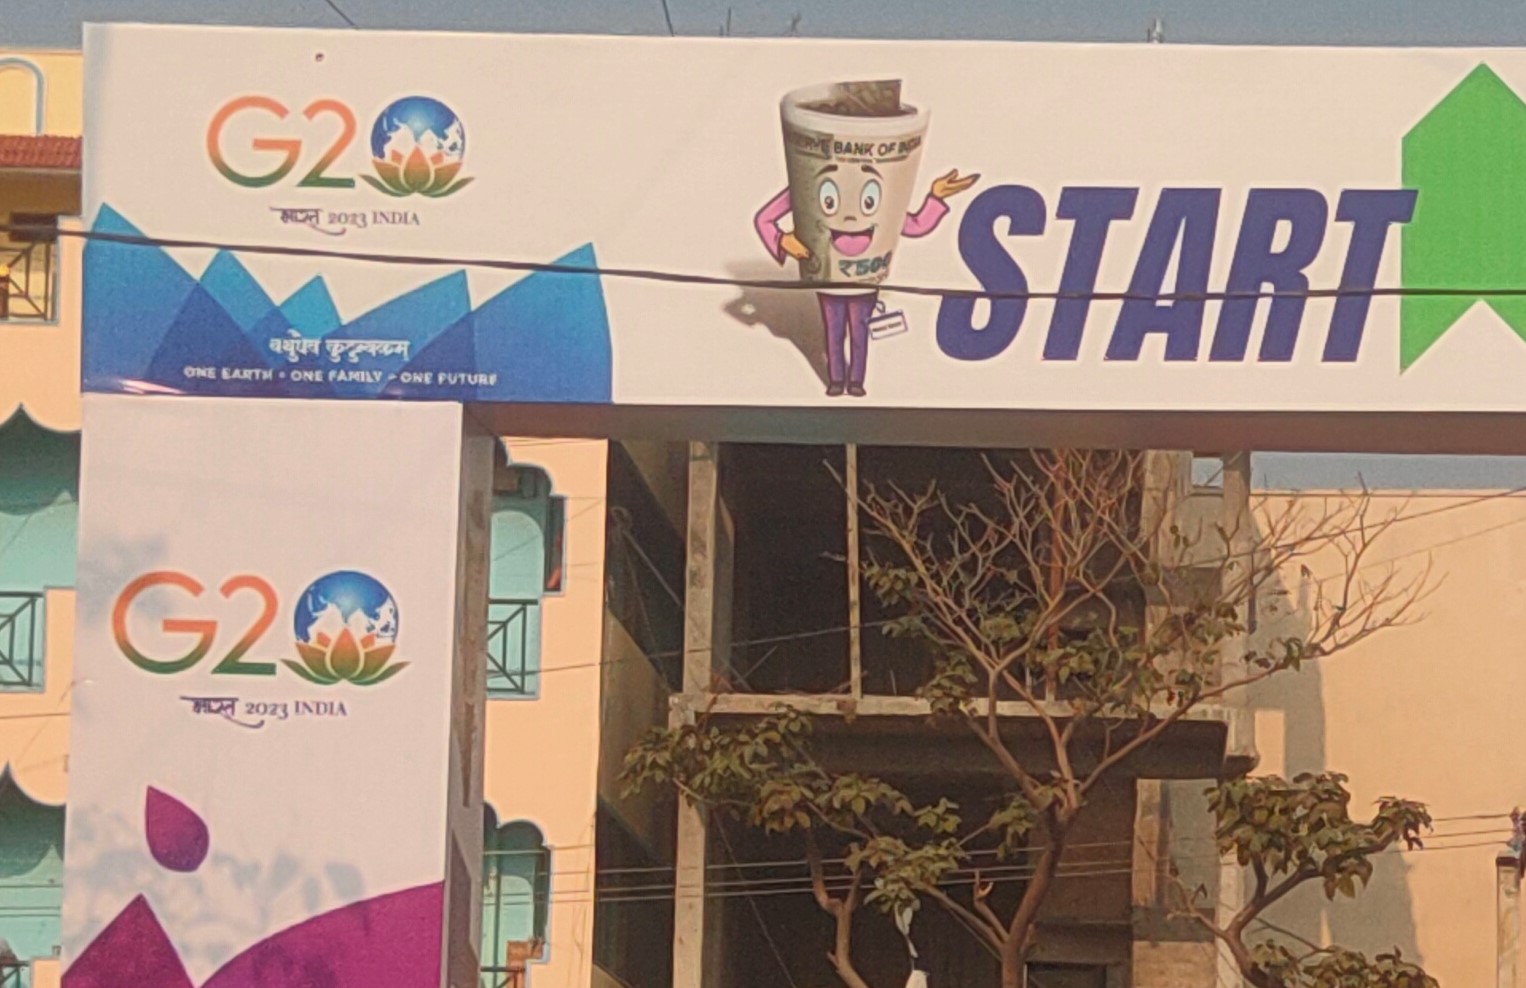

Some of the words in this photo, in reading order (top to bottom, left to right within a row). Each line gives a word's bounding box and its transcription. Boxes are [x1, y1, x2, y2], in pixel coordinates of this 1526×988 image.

[834, 141, 876, 157] BANK
[877, 142, 898, 157] OF
[328, 212, 367, 228] 2023
[372, 211, 421, 227] INDIA
[935, 184, 1419, 363] START
[184, 366, 216, 380] ONE
[221, 366, 273, 382] EARTH
[291, 369, 323, 383] ONE
[328, 370, 383, 384] FAMILY
[400, 371, 432, 385] ONE
[438, 372, 497, 387] FUTURE
[245, 700, 289, 719] 2023
[294, 700, 348, 717] INDIA
